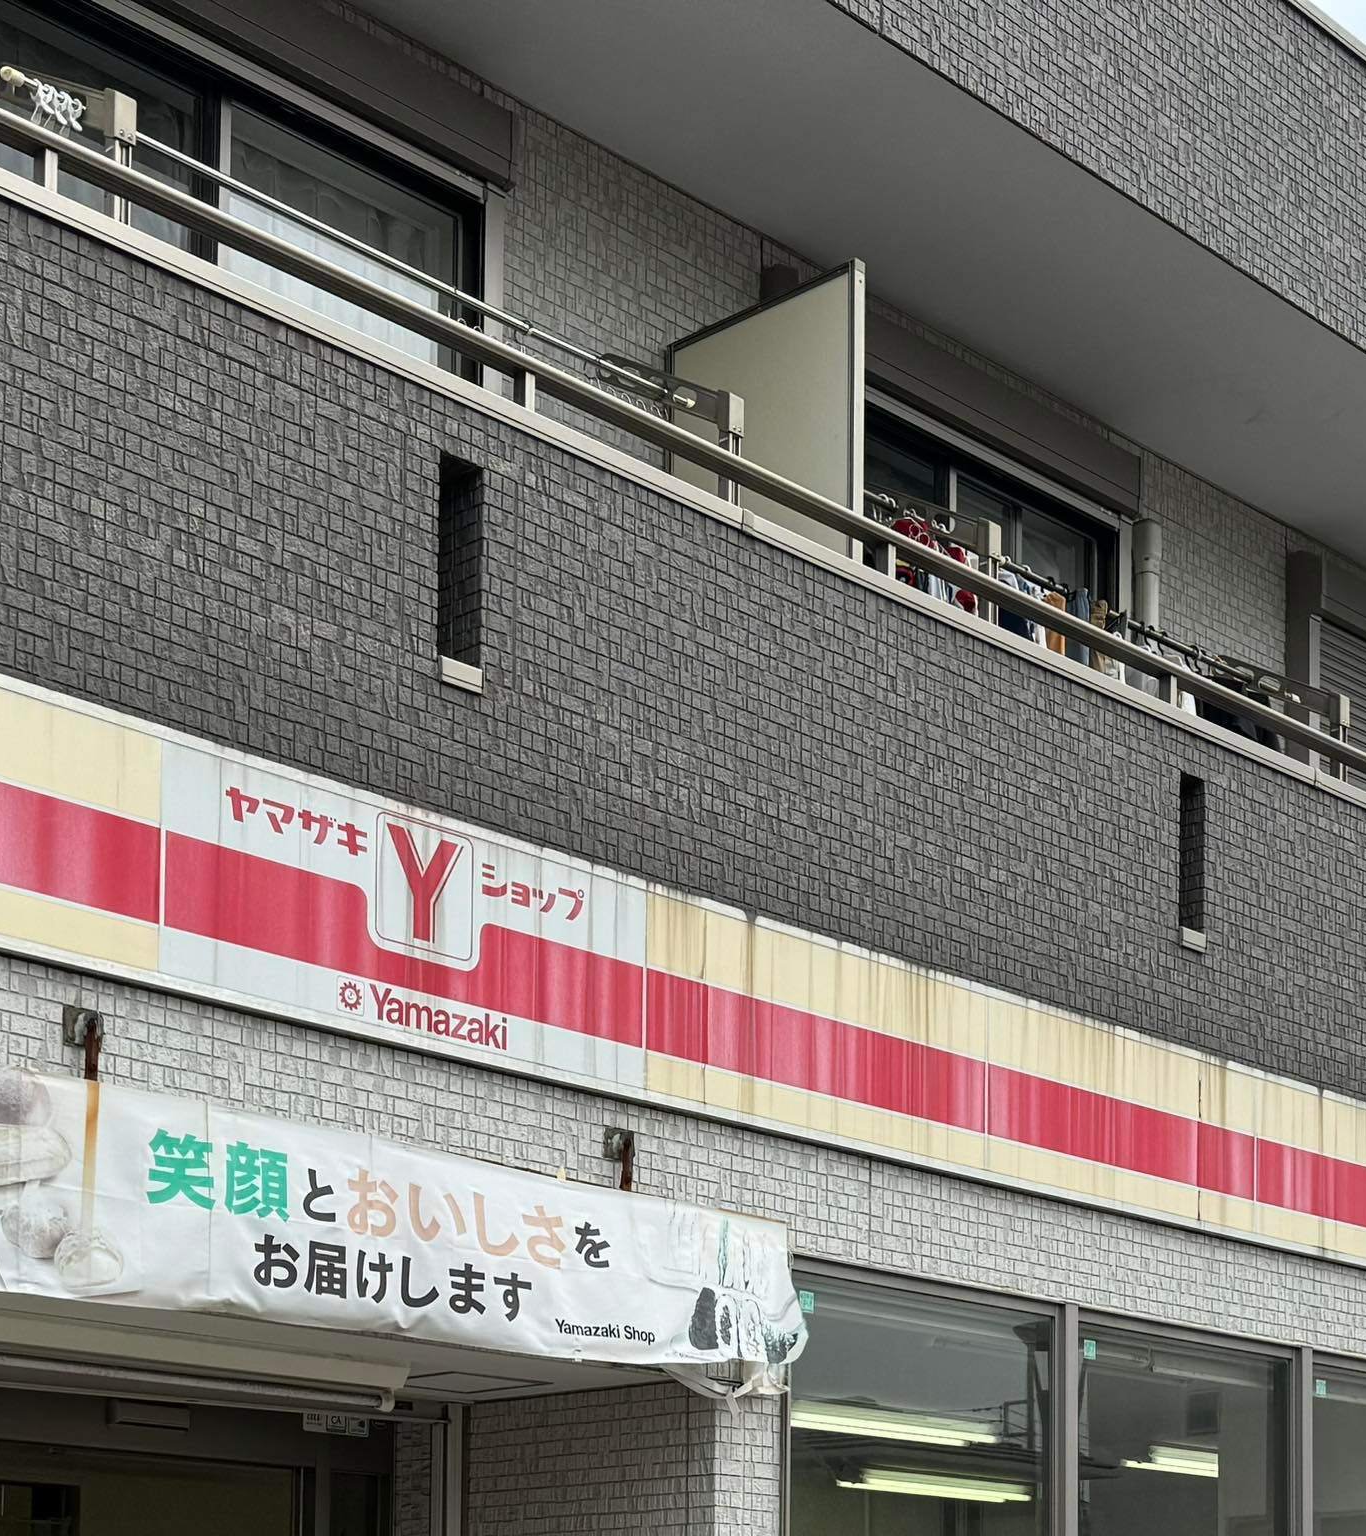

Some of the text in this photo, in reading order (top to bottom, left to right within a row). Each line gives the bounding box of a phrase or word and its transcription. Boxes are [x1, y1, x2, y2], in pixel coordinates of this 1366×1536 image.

[225, 785, 368, 857] ヤマザキ
[386, 821, 465, 945] Y
[481, 862, 585, 921] ショップ
[369, 982, 508, 1051] Yamazaki
[146, 1127, 611, 1270] 笑顔とおいしさを
[254, 1232, 534, 1324] お届けします
[555, 1317, 656, 1345] Yamazaki Shop
